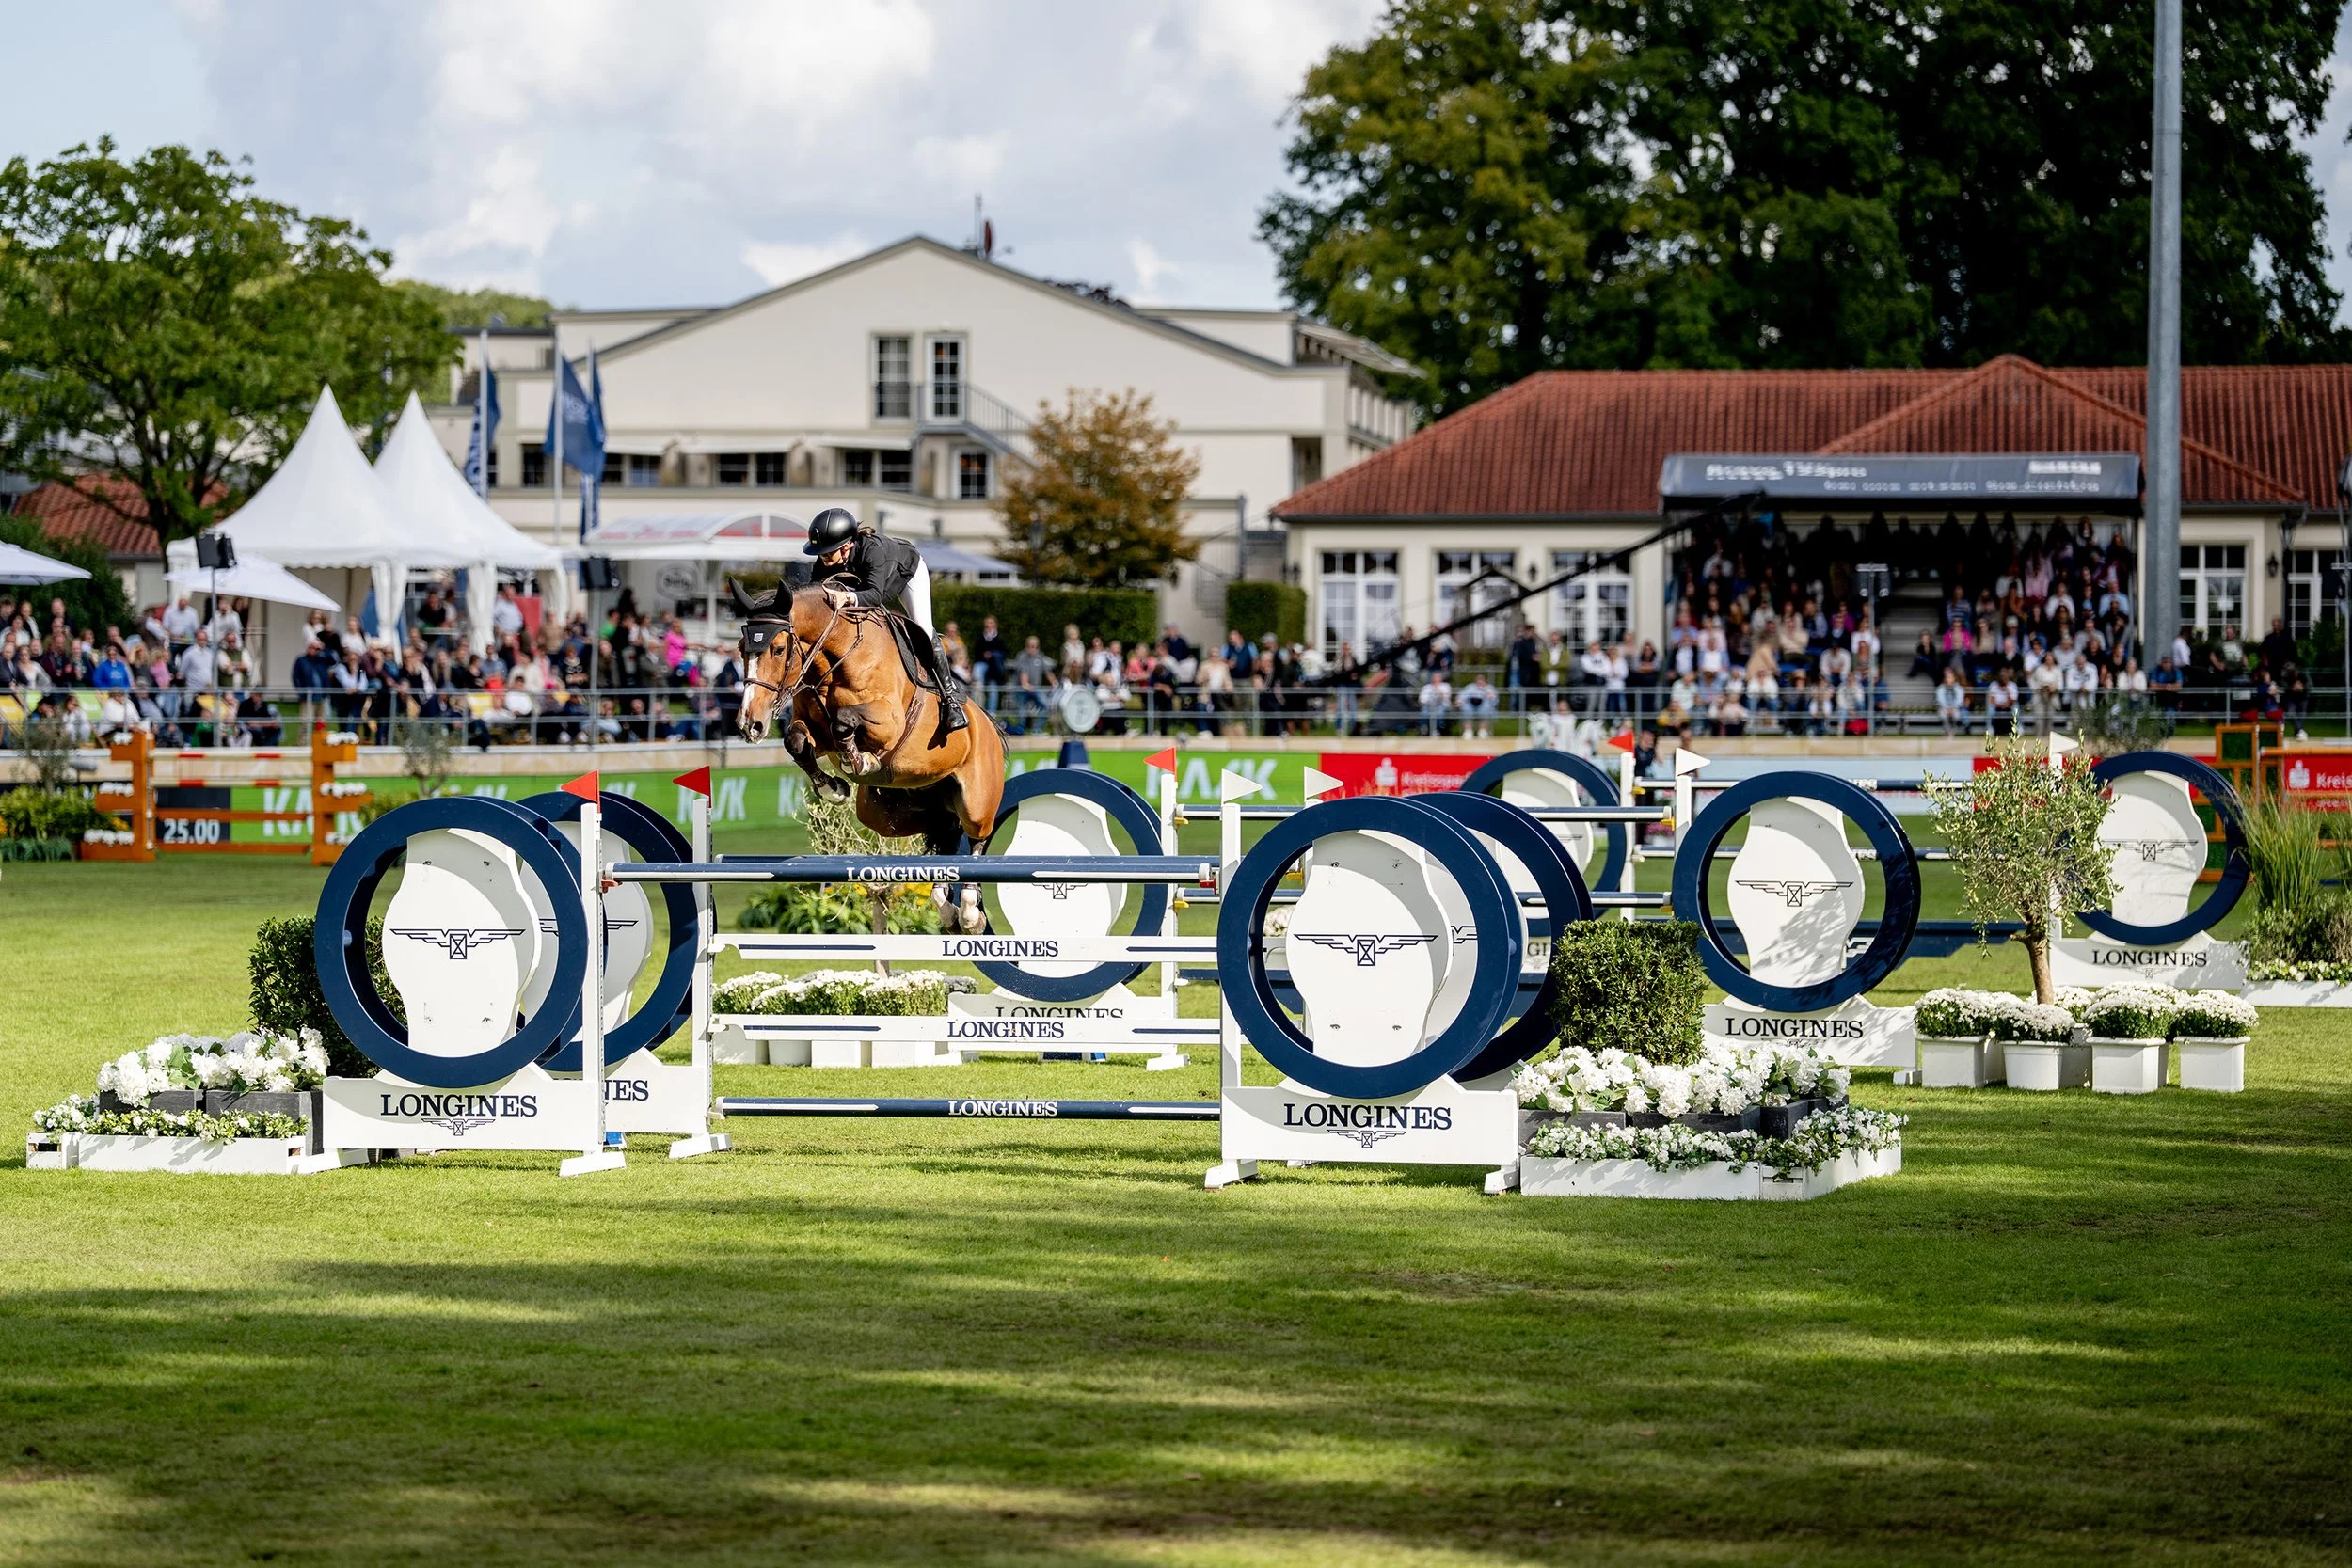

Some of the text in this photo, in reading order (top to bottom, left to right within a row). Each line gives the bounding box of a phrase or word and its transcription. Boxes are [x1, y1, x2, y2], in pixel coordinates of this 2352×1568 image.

[164, 819, 221, 844] 25.00
[847, 866, 960, 882] LONGINES
[943, 940, 1058, 958] LONGINES
[2092, 949, 2207, 968] LONGINES
[947, 1021, 1064, 1038] LONGINES
[1725, 1018, 1864, 1038] LONGINES
[380, 1093, 538, 1117] LONGINES
[948, 1101, 1057, 1117] LONGINES
[1283, 1103, 1453, 1130] LONGINES
